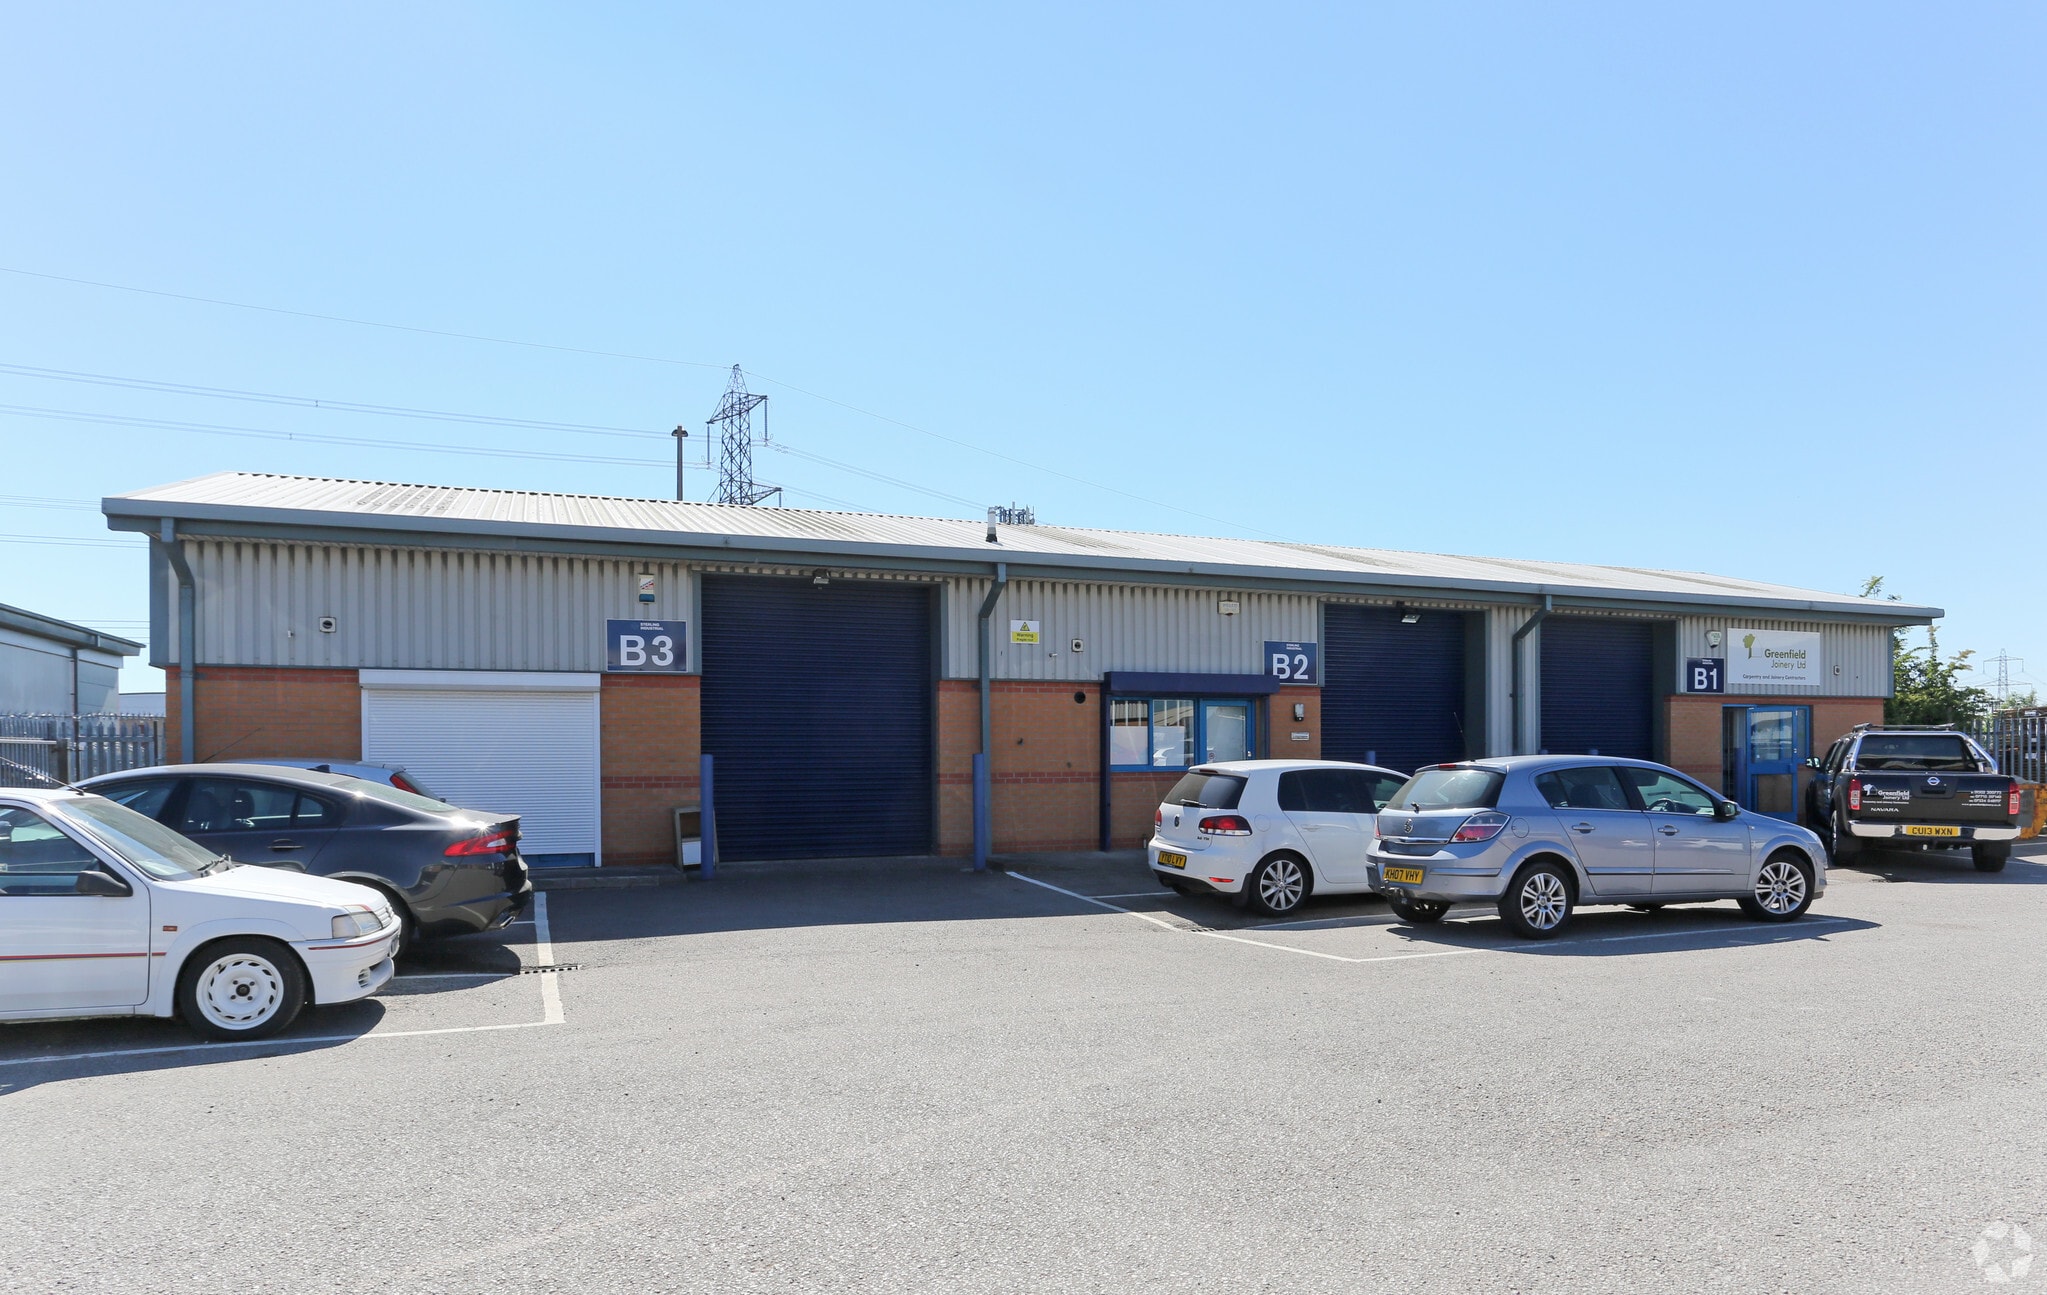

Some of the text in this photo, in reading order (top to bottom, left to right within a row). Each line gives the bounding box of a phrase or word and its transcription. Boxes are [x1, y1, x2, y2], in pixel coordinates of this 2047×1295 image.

[620, 634, 674, 666] B3
[1764, 648, 1806, 659] Greenfield
[1272, 653, 1309, 680] B2
[1771, 659, 1807, 671] Joinery Ltd
[1694, 667, 1717, 690] B1
[1911, 827, 1953, 836] CU13 WXN
[1385, 868, 1420, 881] KH07 VHY
